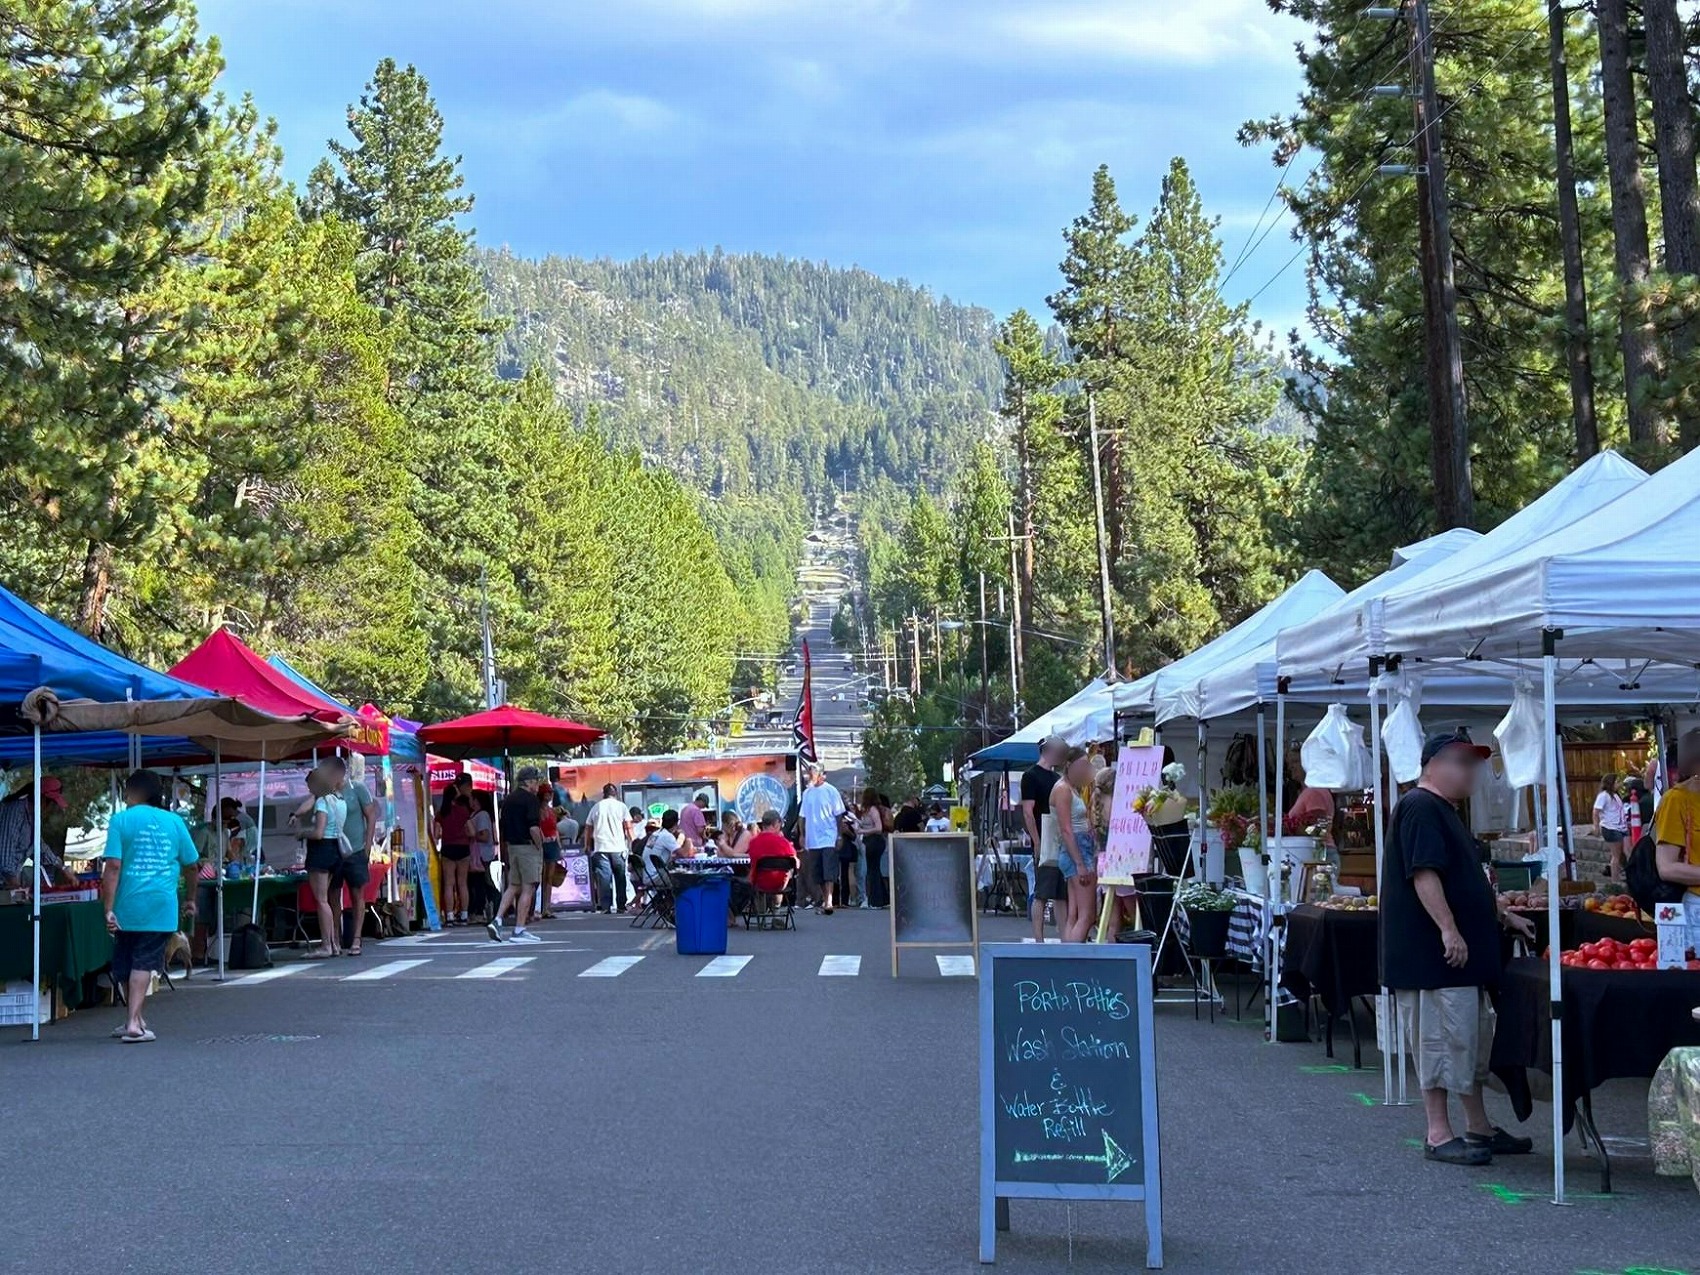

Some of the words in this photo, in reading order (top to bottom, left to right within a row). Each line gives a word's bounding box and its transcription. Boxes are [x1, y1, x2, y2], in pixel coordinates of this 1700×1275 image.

[1004, 1026, 1055, 1062] Wash
[1060, 1025, 1131, 1061] Station
[1000, 1090, 1045, 1119] Water
[1049, 1085, 1116, 1118] Bottle
[1042, 1115, 1087, 1143] Refill
